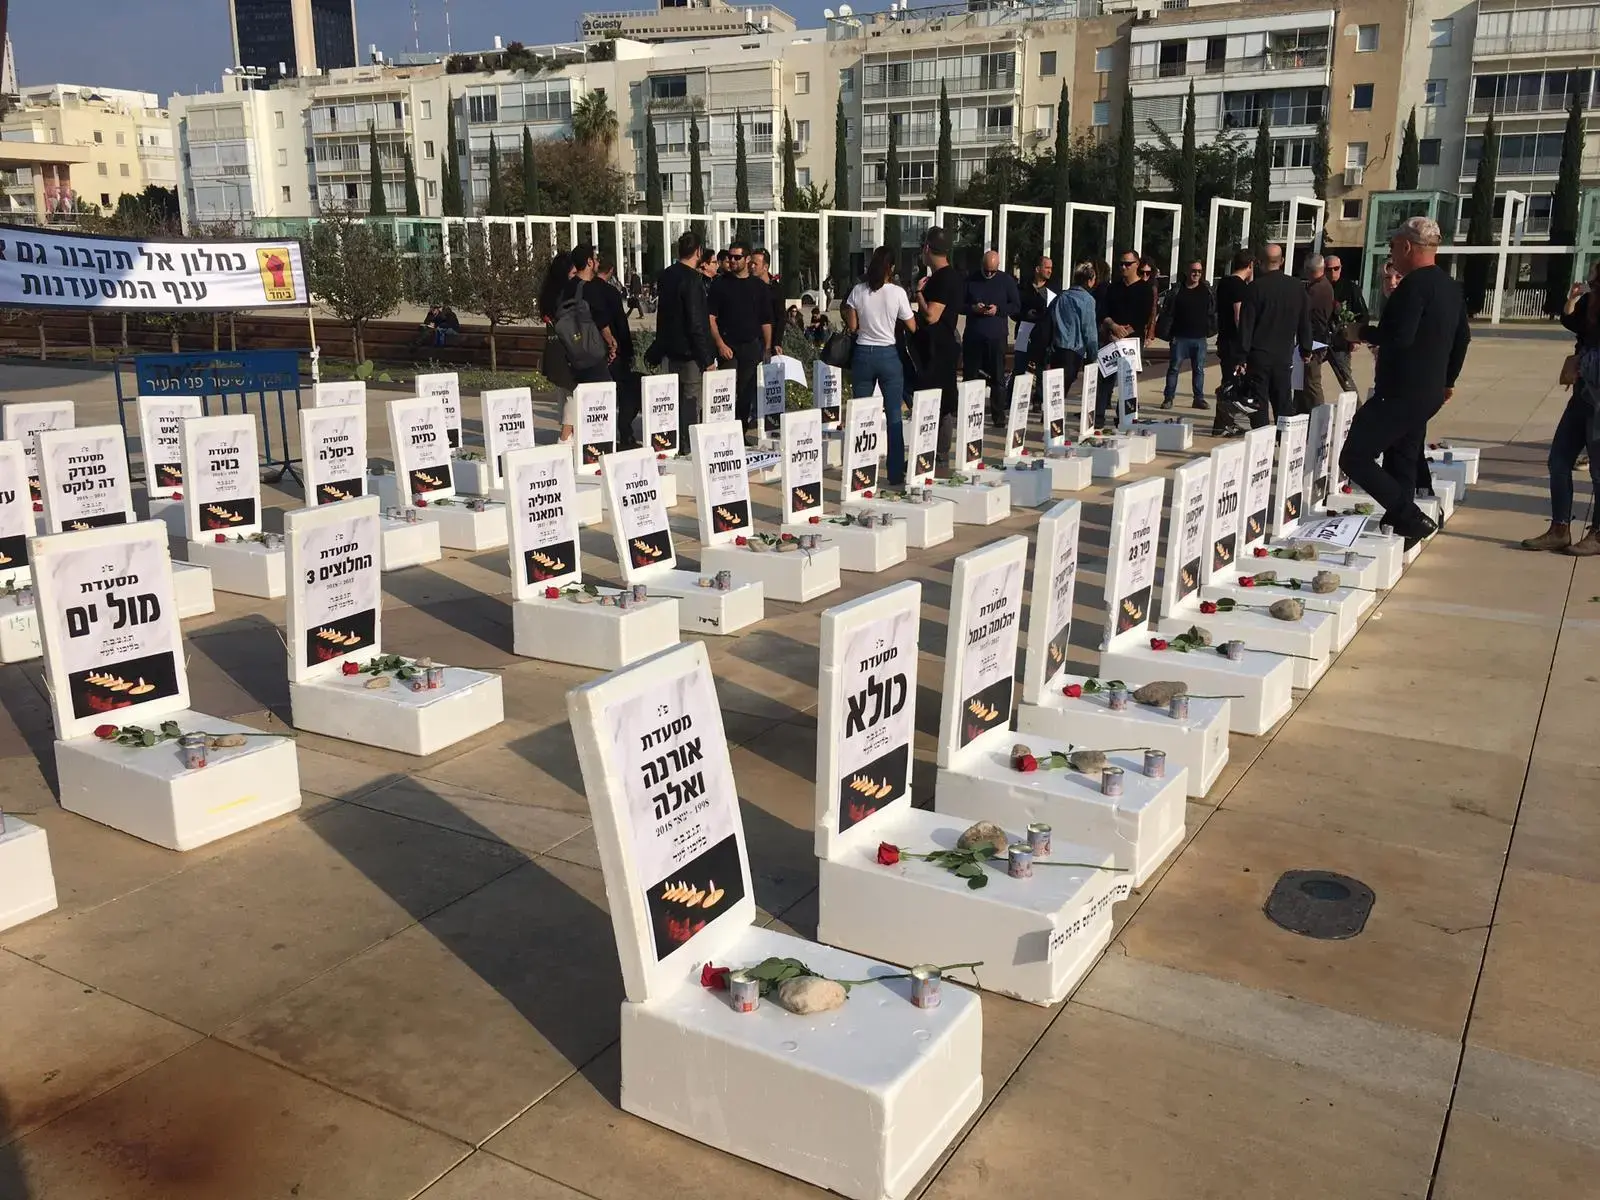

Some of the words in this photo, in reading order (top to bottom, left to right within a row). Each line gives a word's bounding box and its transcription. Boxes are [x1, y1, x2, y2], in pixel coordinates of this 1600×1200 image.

[592, 20, 622, 29] Guesty
[15, 241, 47, 264] גם
[54, 245, 134, 274] תקבור
[137, 246, 175, 271] אל
[181, 248, 247, 276] כחלון
[21, 273, 156, 299] המסעדנות
[162, 281, 207, 304] ענף
[269, 291, 292, 299] ביחד
[146, 376, 180, 392] העיר
[184, 376, 204, 389] פני
[712, 394, 731, 404] טאפס
[588, 404, 607, 412] מסעדת
[710, 405, 722, 414] העם
[722, 404, 733, 413] אחד
[411, 423, 434, 432] מסעדת
[499, 420, 526, 433] ווינברג
[859, 420, 875, 429] מסעדת
[322, 435, 349, 444] מסעדת
[411, 431, 437, 445] כתית
[796, 438, 813, 447] מסעדת
[854, 430, 877, 454] כולא
[68, 453, 104, 465] מסעדת
[208, 447, 240, 456] מסעדת
[713, 449, 734, 458] מסעדת
[791, 448, 819, 464] קורדיליה
[68, 464, 107, 481] פונדק
[210, 459, 240, 471] בויה
[708, 459, 742, 475] סרווסריה
[62, 479, 95, 495] לוקס
[98, 477, 116, 489] דה
[529, 478, 558, 491] מסעדת
[625, 479, 649, 490] מסעדת
[528, 491, 562, 508] אמיליה
[622, 496, 628, 507] 5
[631, 489, 657, 505] סינמה
[528, 505, 564, 523] רומאנה
[1132, 526, 1150, 540] מסעדת
[320, 542, 358, 559] מסעדת
[1128, 546, 1138, 562] 23
[320, 554, 372, 581] החלוצים
[80, 574, 139, 593] מסעדת
[306, 569, 316, 585] 3
[106, 592, 161, 630] מול
[979, 596, 1007, 618] מסעדת
[65, 603, 98, 638] ים
[988, 611, 1015, 636] יהלומה
[968, 623, 987, 646] בנמל
[859, 646, 898, 673] מסעדת
[846, 672, 908, 739] כולא
[640, 714, 693, 752] מסעדת
[640, 736, 704, 789] אורנה
[652, 770, 706, 821] ואלה
[655, 819, 673, 838] 2018
